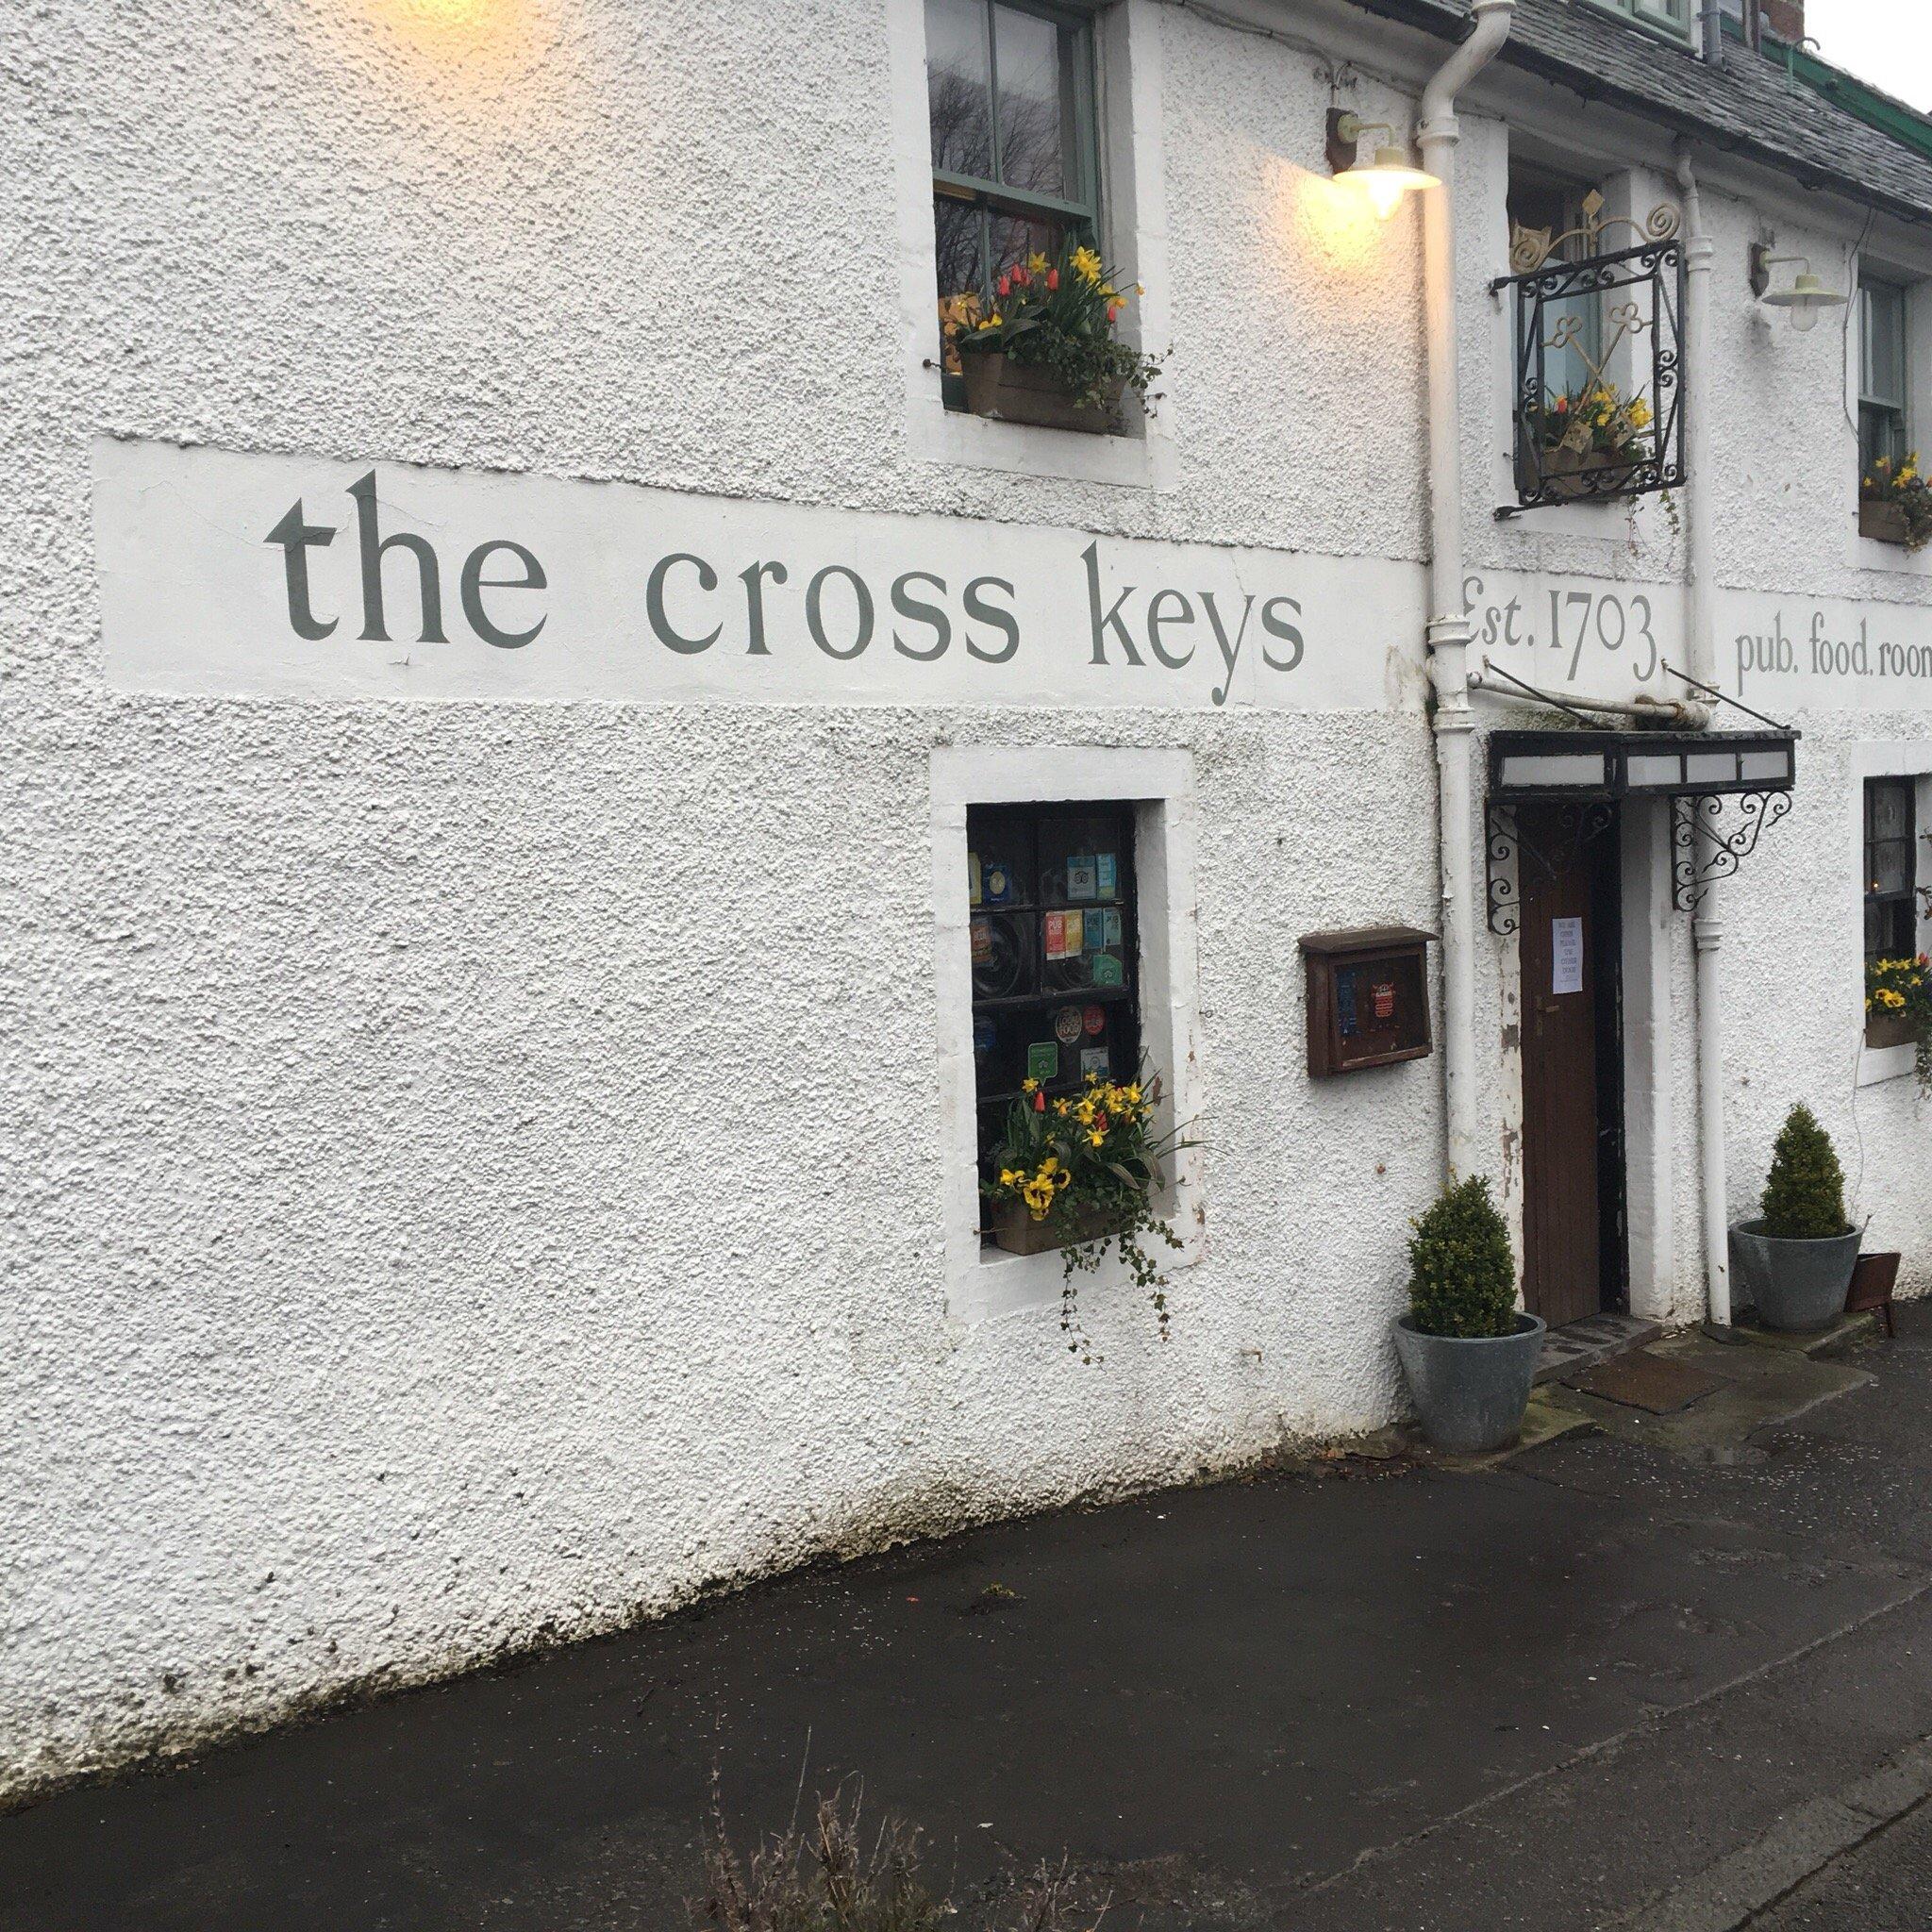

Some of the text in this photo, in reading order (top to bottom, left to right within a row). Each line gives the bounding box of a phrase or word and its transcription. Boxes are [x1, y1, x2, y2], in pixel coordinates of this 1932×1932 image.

[263, 469, 1306, 707] the cross keys
[1548, 589, 1657, 682] 1703
